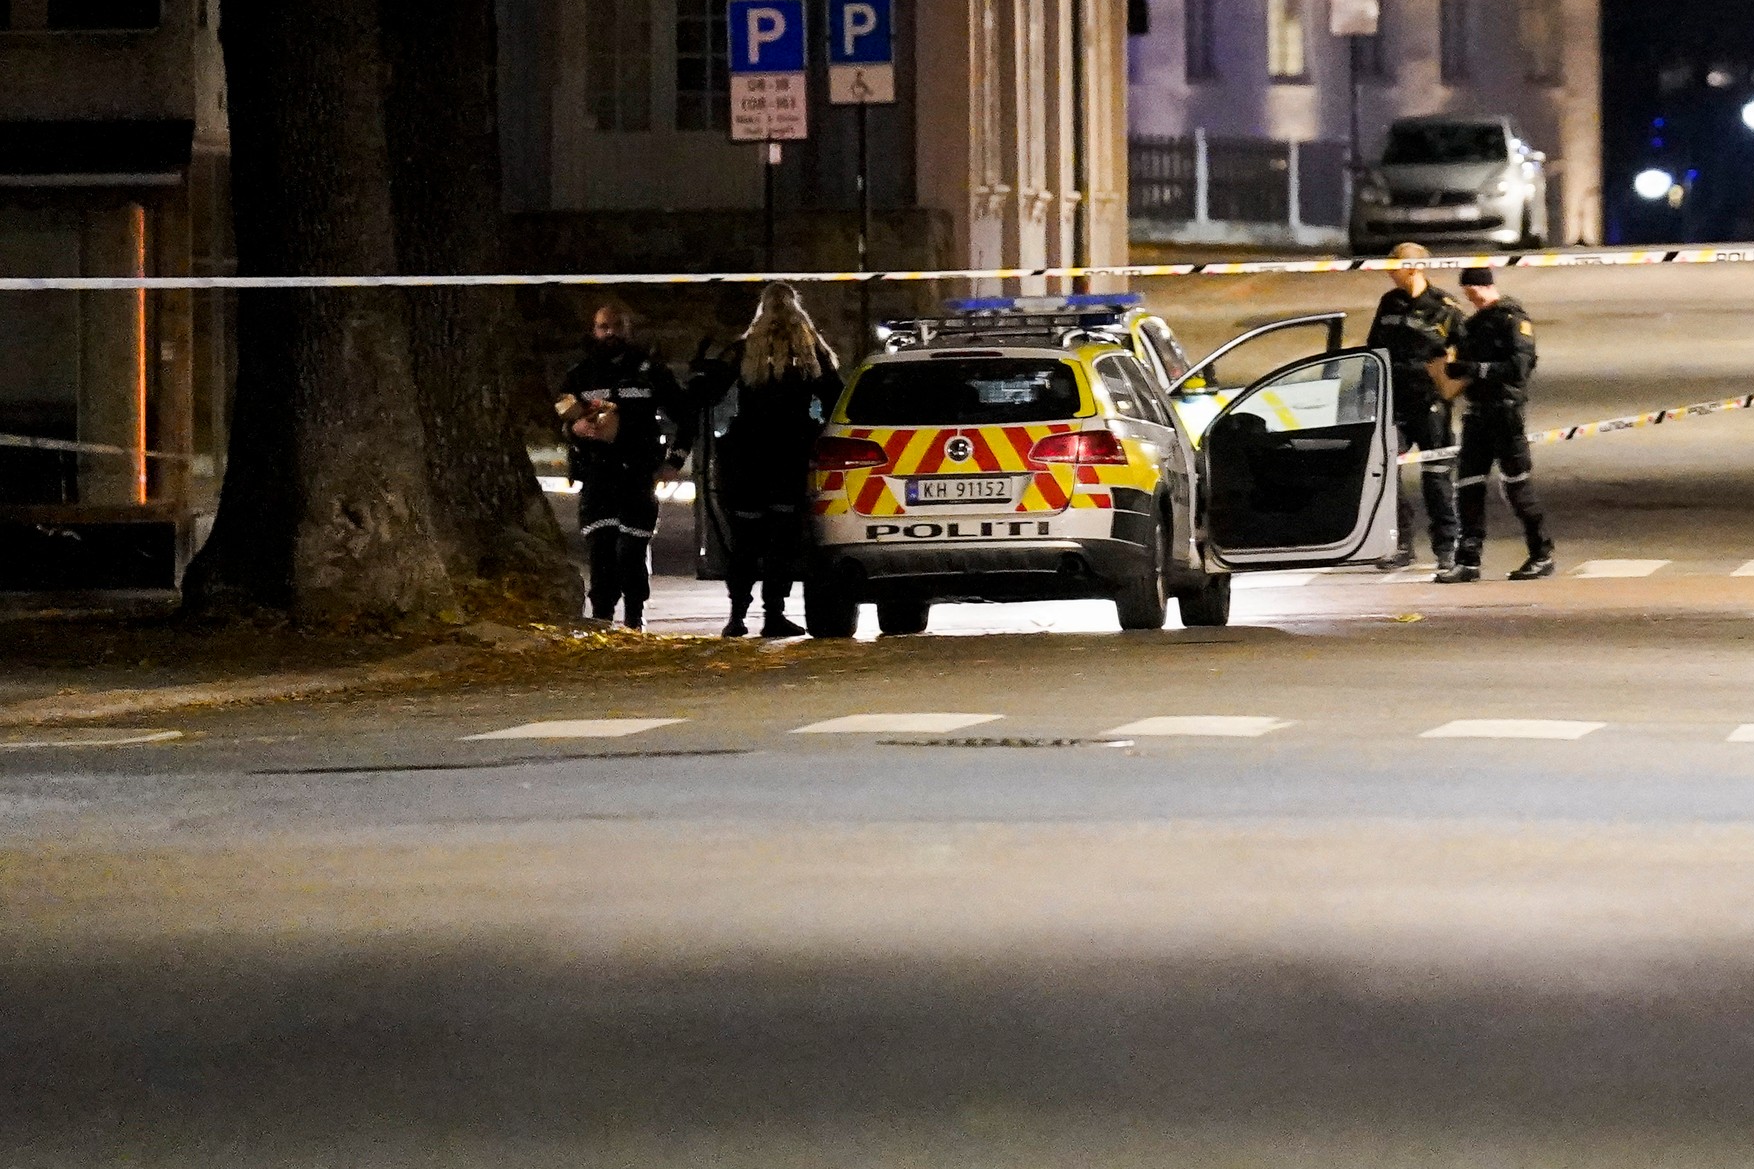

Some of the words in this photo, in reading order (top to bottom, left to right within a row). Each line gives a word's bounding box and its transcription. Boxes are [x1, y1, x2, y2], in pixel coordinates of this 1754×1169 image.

[747, 7, 787, 65] P
[843, 3, 877, 56] P
[923, 484, 947, 498] KH
[956, 481, 1005, 497] 91152
[866, 521, 1050, 539] POLITI
